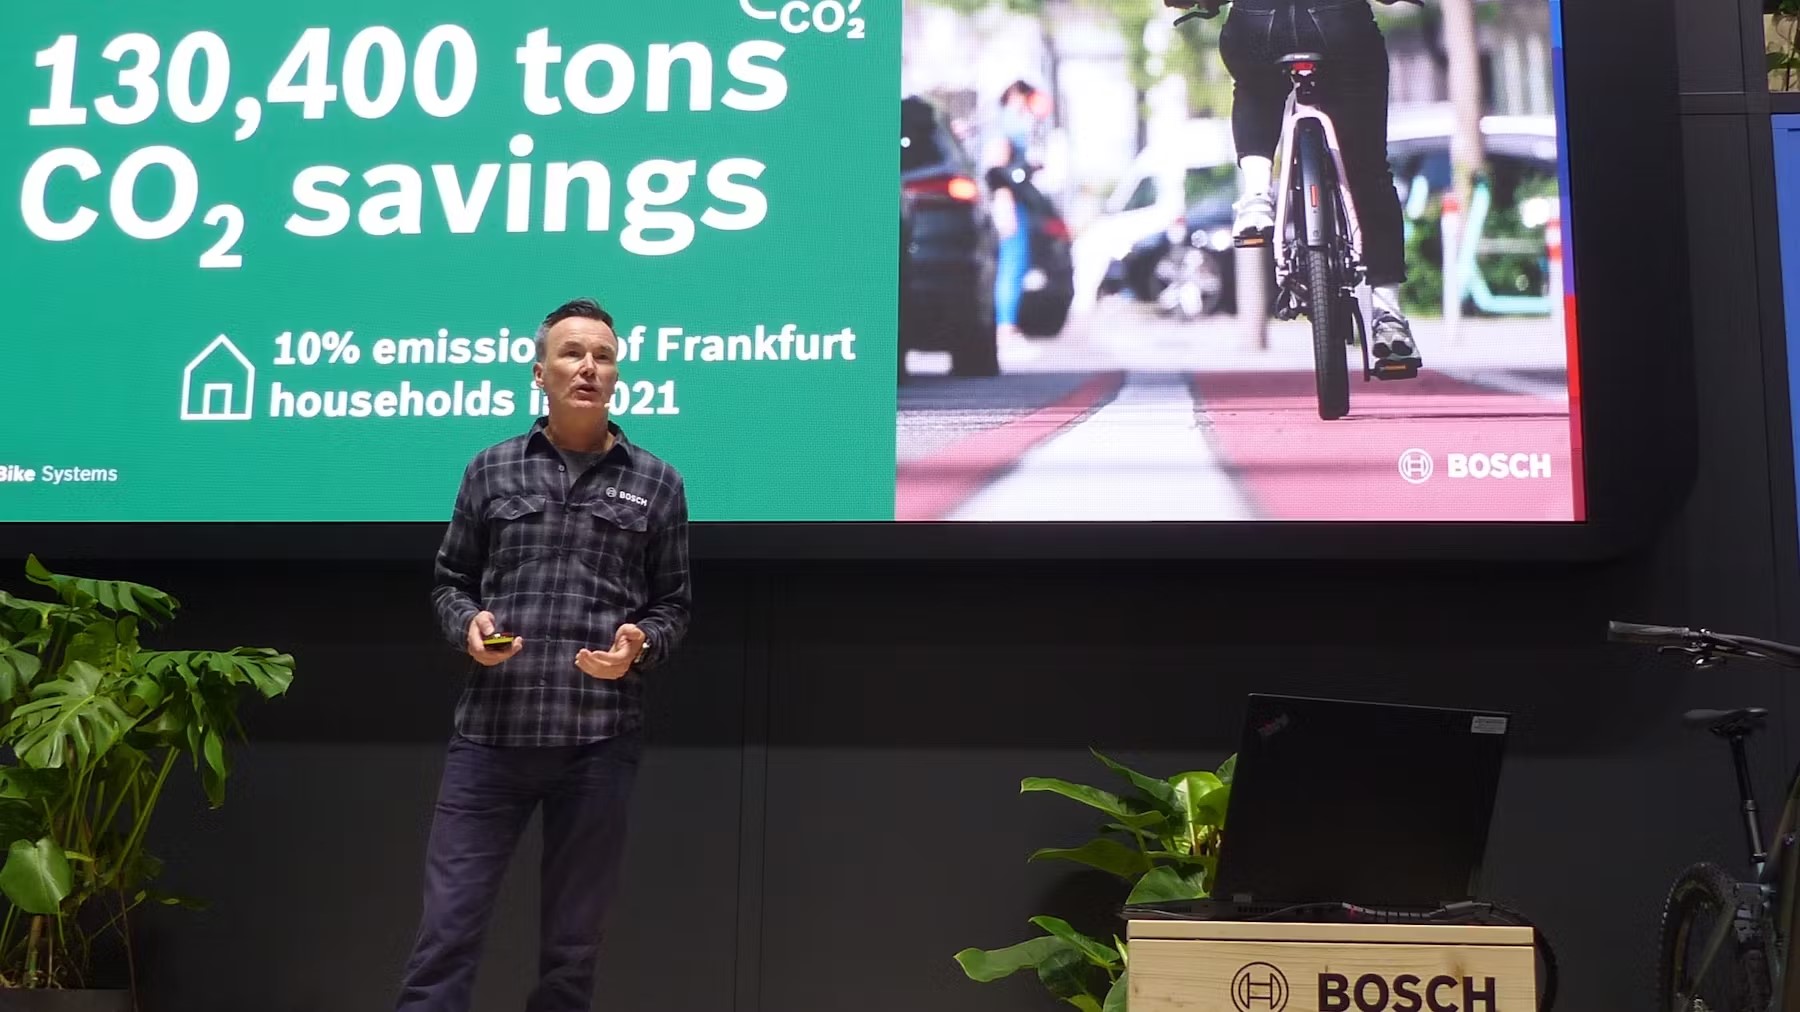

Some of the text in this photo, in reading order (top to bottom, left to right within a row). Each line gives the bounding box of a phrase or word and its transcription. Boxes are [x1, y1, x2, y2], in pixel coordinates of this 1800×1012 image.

[28, 23, 789, 141] 130,400 tons
[284, 133, 768, 256] savings
[273, 330, 361, 366] 10%
[372, 327, 536, 365] emissio
[656, 323, 857, 362] Frankfurt
[269, 379, 515, 418] households
[608, 379, 680, 416] 021
[41, 465, 118, 485] Systems
[1447, 452, 1552, 480] BOSCH
[619, 490, 648, 507] BOSCH
[1317, 972, 1496, 1012] BOSCH
